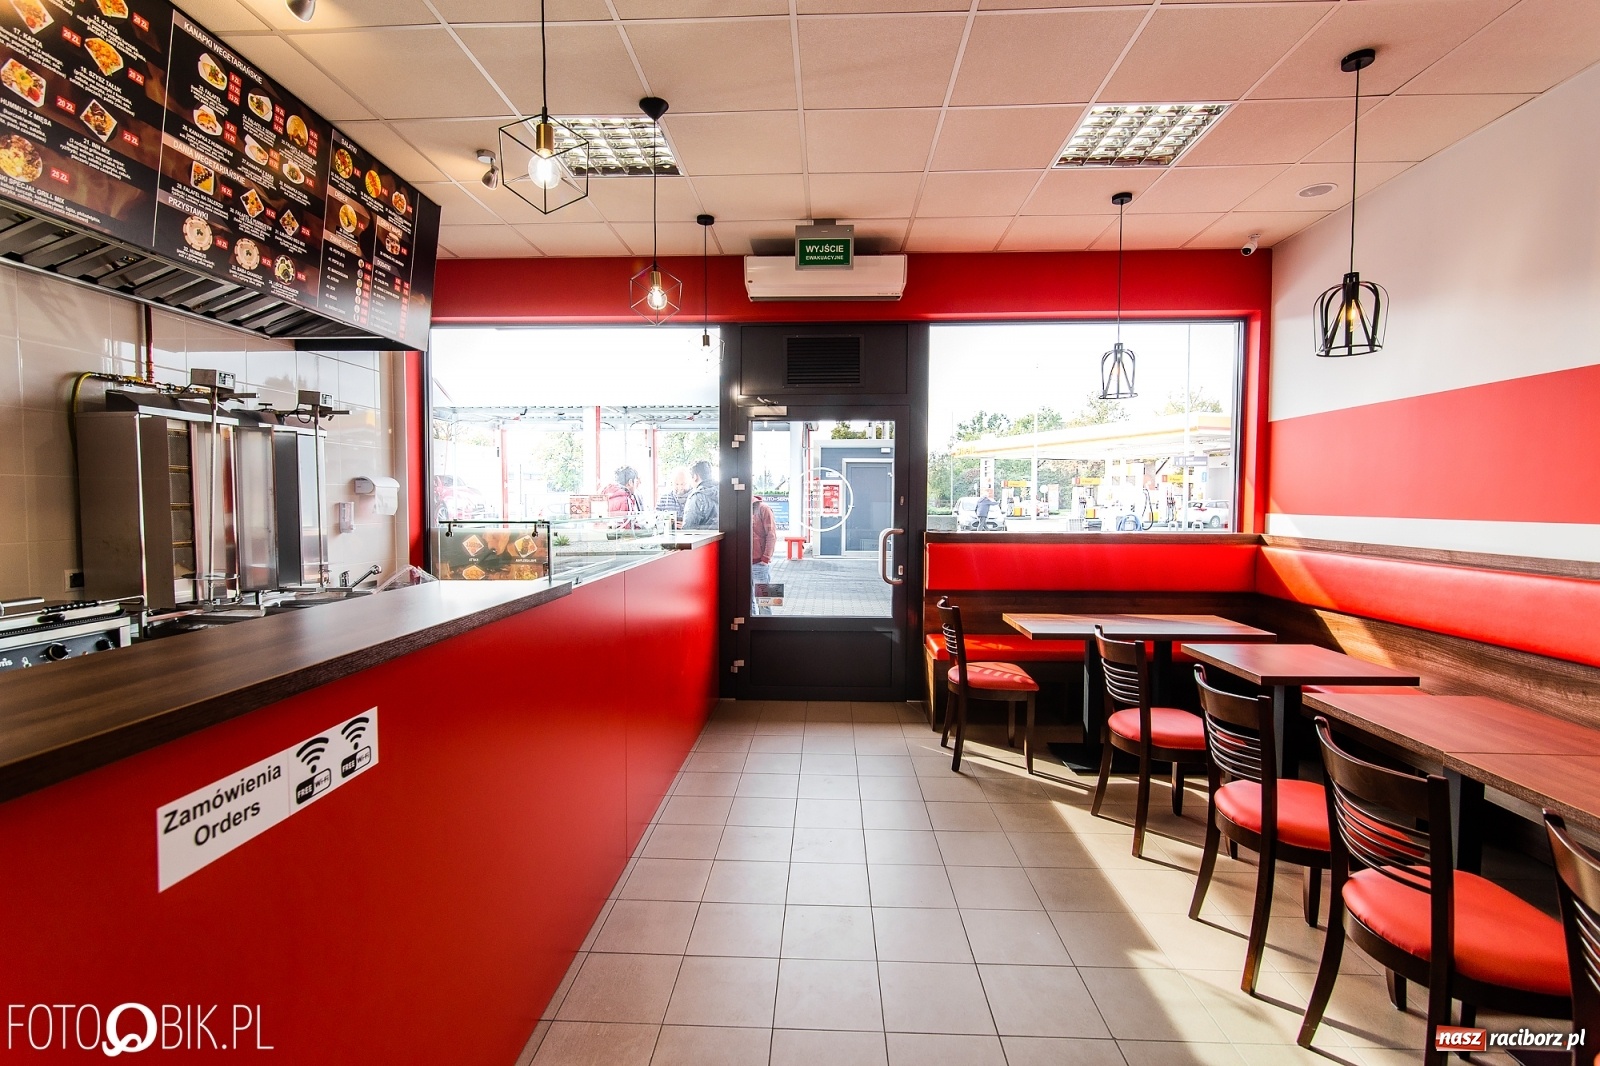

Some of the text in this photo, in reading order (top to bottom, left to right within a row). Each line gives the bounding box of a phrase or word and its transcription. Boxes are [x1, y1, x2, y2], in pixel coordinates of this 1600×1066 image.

[22, 32, 43, 49] KAFTA
[184, 21, 262, 85] KANAPKI WEGETARIAŃSKIE
[57, 97, 65, 108] 20
[28, 110, 32, 118] Z
[173, 140, 193, 157] DANIA
[194, 150, 245, 185] WEGETARIAŃSKIE
[51, 168, 59, 179] 25
[36, 189, 53, 200] GRILL
[54, 196, 64, 204] MIX
[168, 196, 208, 220] PRZYSTAWKI
[806, 244, 844, 253] WYJŚCIE
[342, 752, 370, 773] FREE Wi-Fi
[297, 775, 330, 799] FREE Wi-Fi
[163, 764, 281, 835] Zamówienia
[194, 802, 261, 847] Orders
